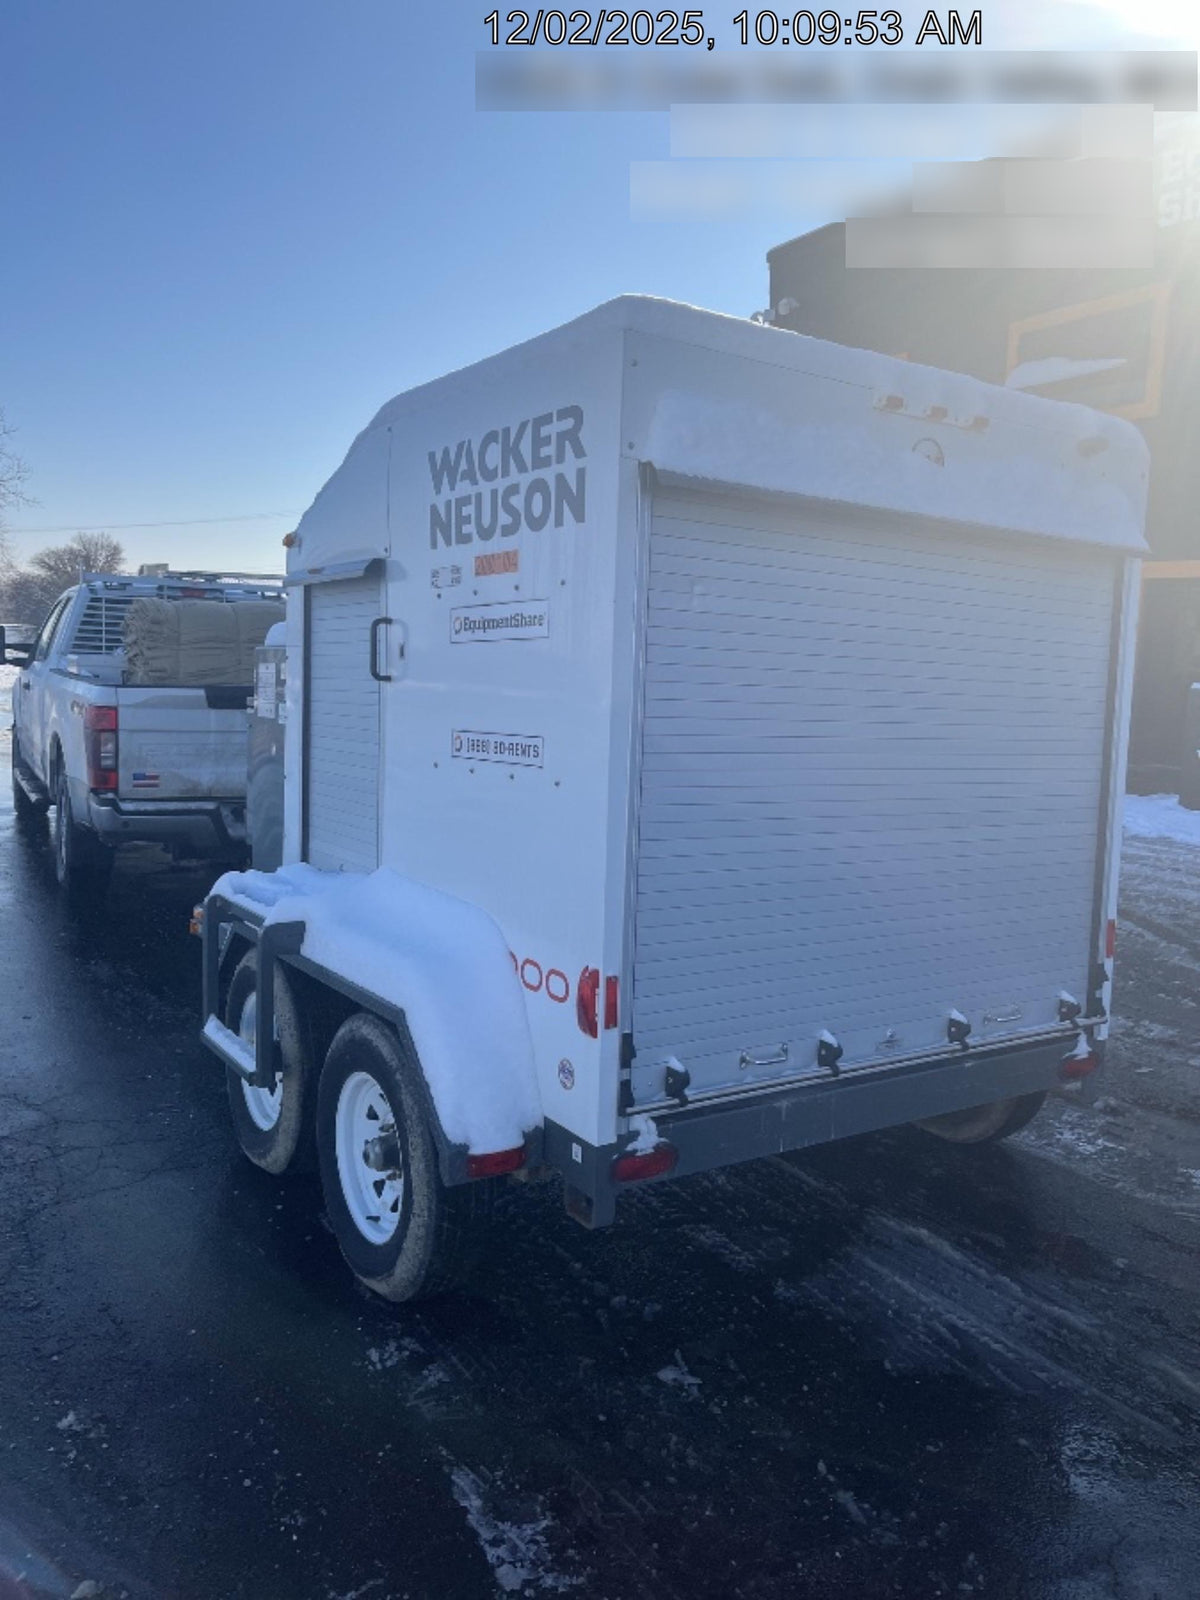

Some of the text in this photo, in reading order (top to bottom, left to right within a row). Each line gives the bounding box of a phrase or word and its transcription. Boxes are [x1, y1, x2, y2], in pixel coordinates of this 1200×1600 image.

[428, 404, 588, 495] WACKER
[429, 466, 587, 549] NEUSON
[463, 612, 544, 633] EquipmentShare
